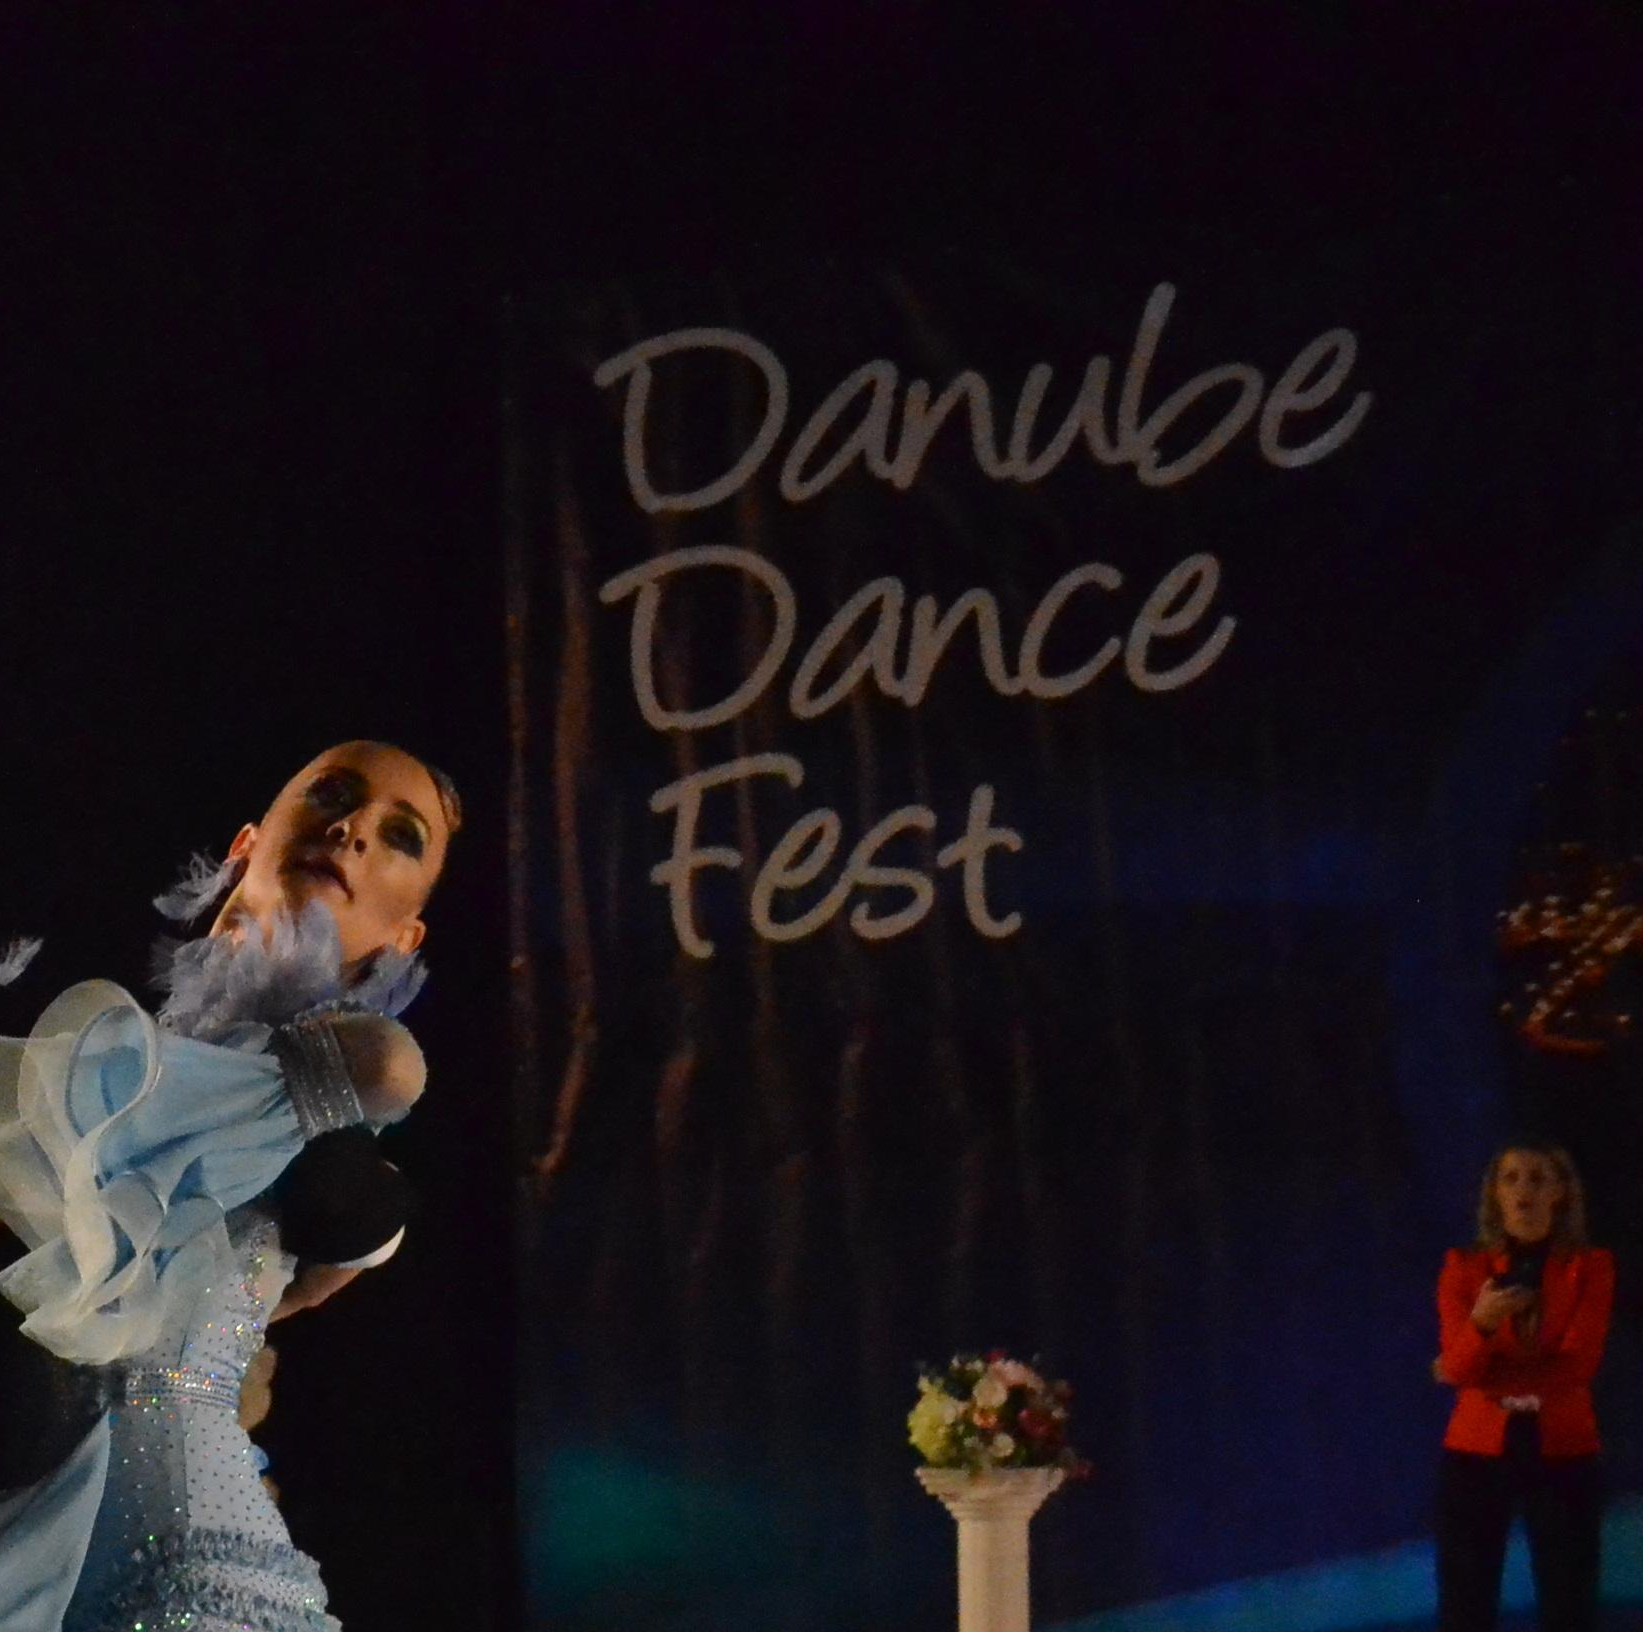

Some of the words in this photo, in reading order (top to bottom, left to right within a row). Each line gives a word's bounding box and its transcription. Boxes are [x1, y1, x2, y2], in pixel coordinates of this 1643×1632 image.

[595, 283, 1372, 514] Danube
[598, 545, 1237, 731] Dance
[649, 752, 1025, 960] Fest
